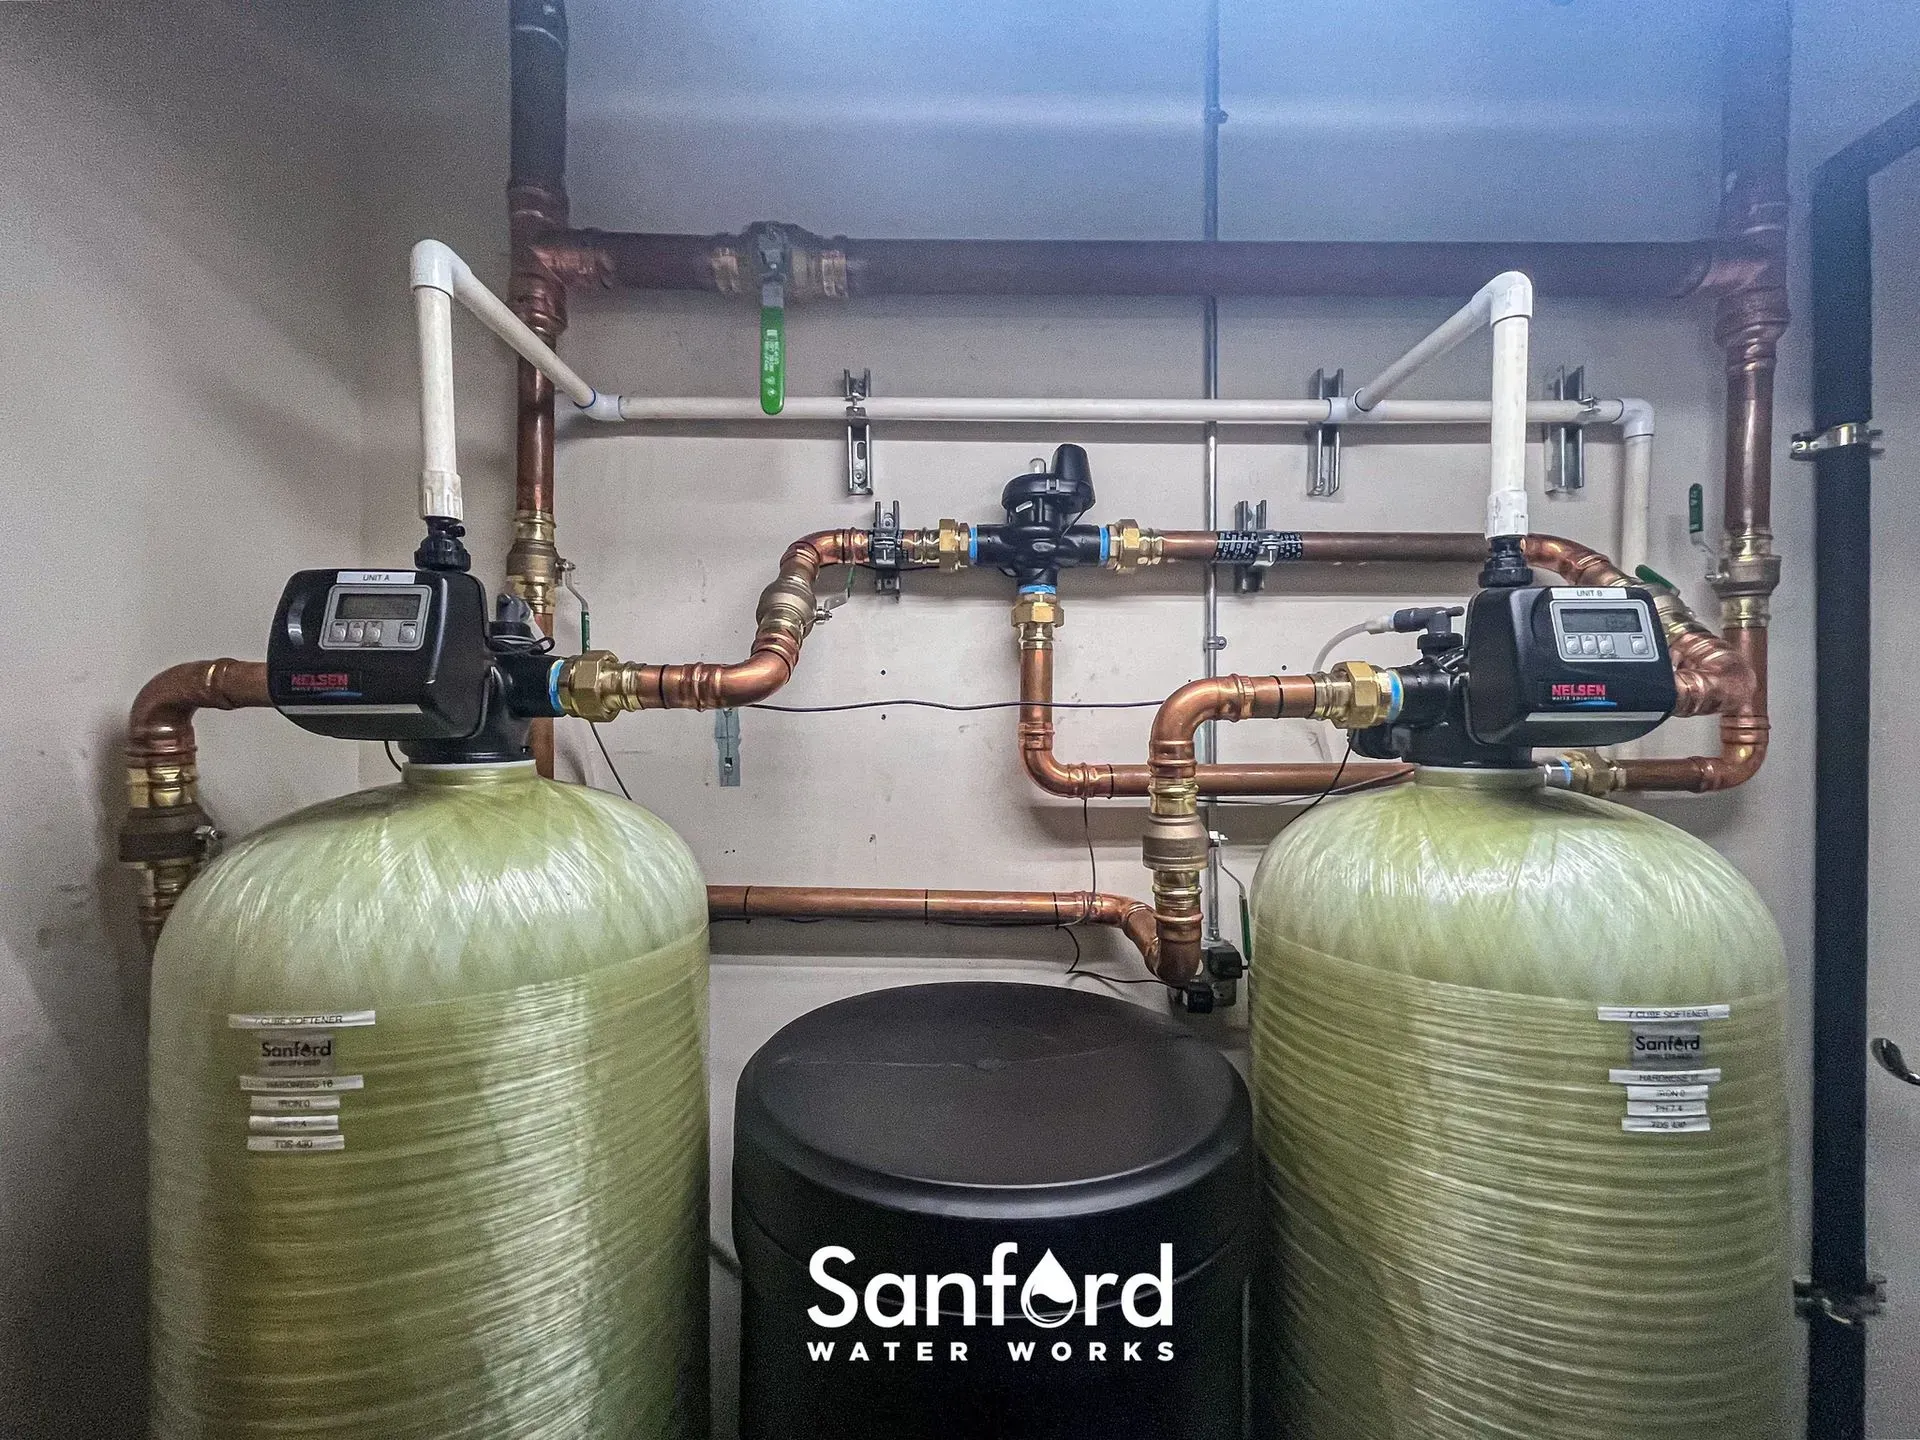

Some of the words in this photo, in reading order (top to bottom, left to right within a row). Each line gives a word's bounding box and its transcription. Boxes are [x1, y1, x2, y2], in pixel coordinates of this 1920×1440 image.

[291, 673, 349, 686] NELSEN
[1551, 684, 1606, 696] NELSEN
[1663, 1009, 1709, 1018] SOFTENER
[290, 1015, 343, 1025] SOFTENER
[262, 1040, 332, 1057] Sanford
[1635, 1035, 1700, 1051] Sanford
